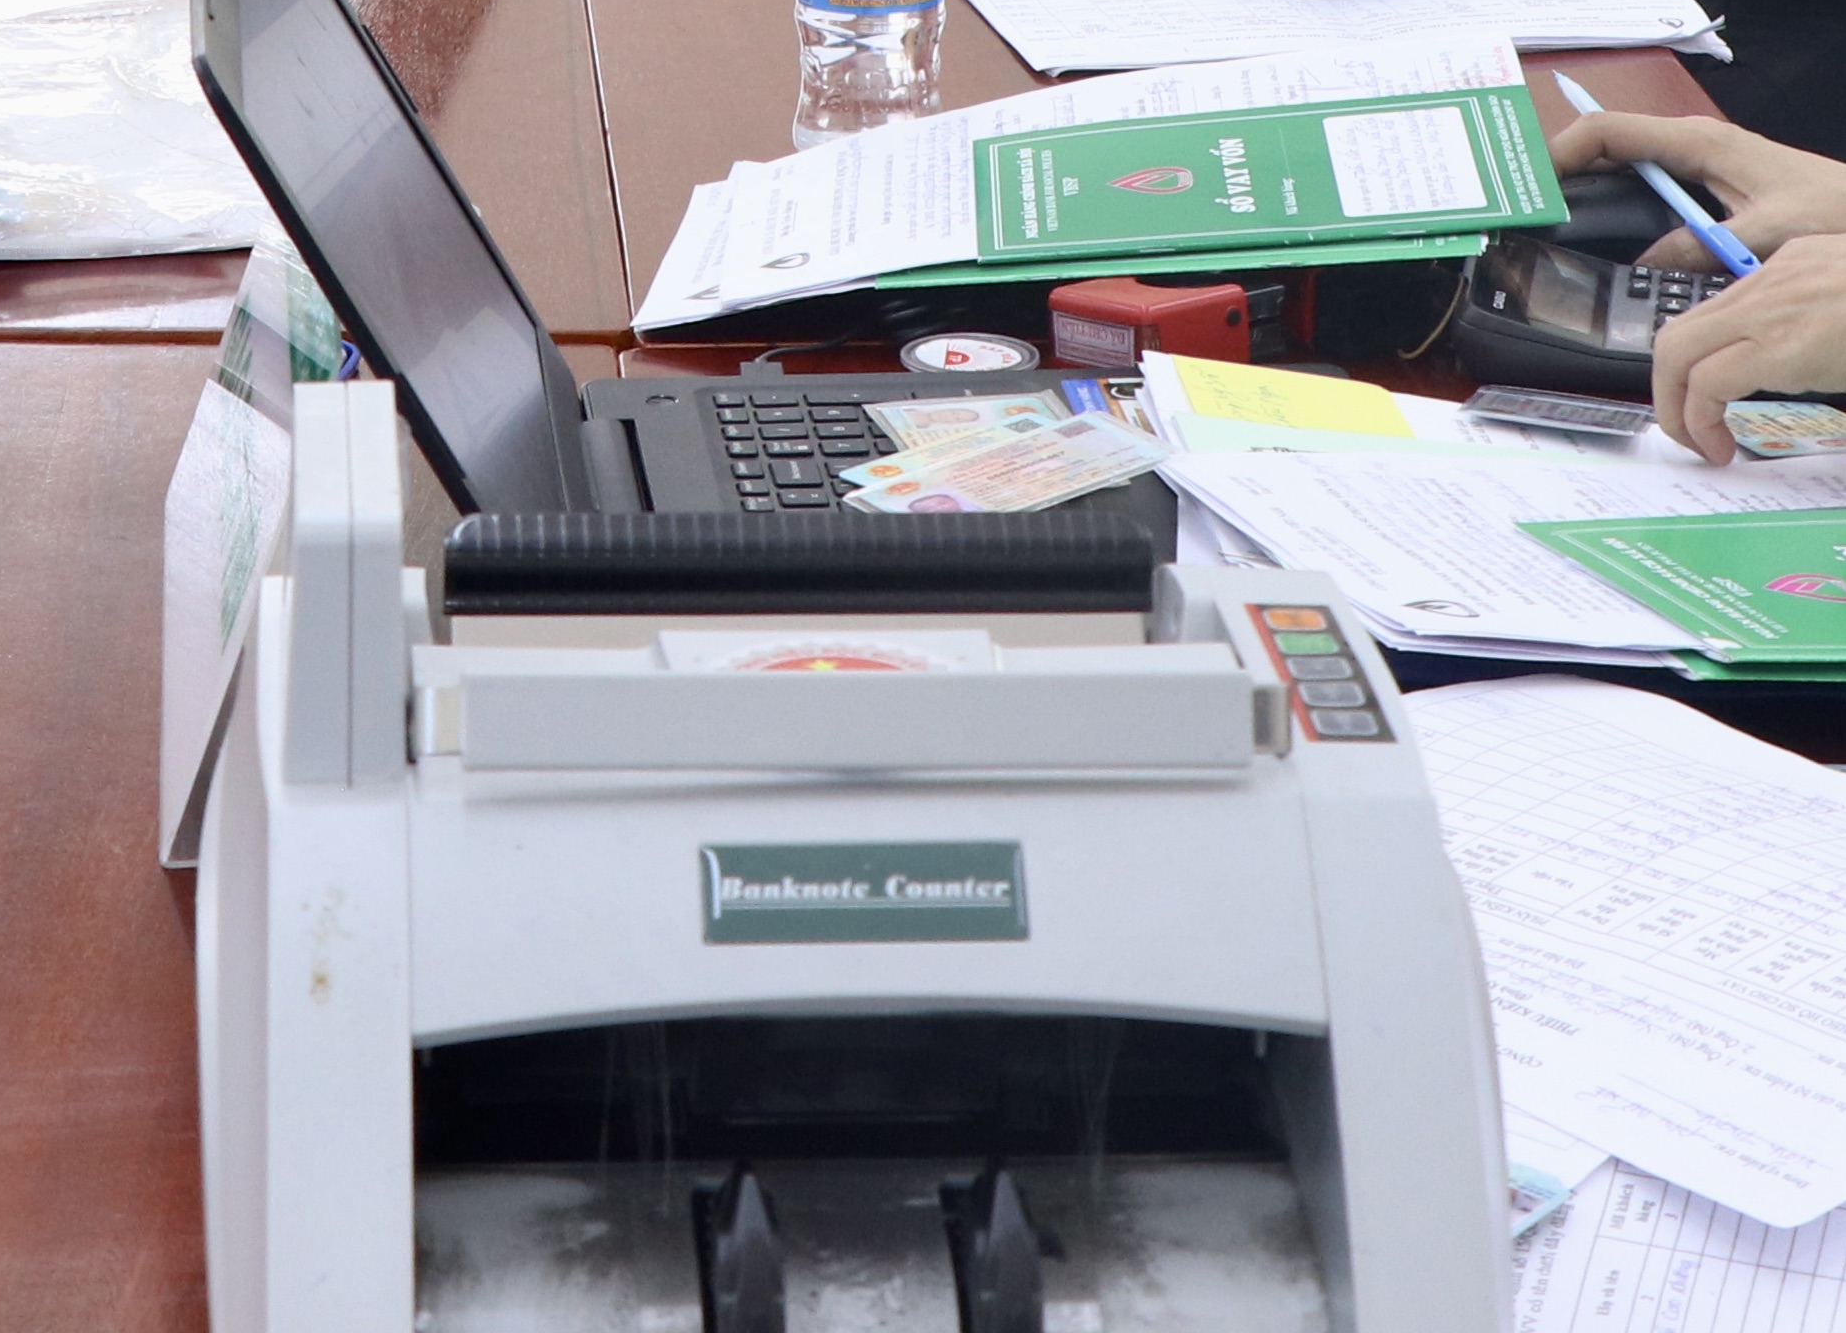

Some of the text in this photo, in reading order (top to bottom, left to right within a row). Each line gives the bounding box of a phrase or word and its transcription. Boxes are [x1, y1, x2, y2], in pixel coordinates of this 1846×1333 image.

[1209, 139, 1255, 212] SỔ VAY VỐN
[720, 873, 1011, 900] Banknote Counter
[1535, 1014, 1579, 1036] PHIẾU
